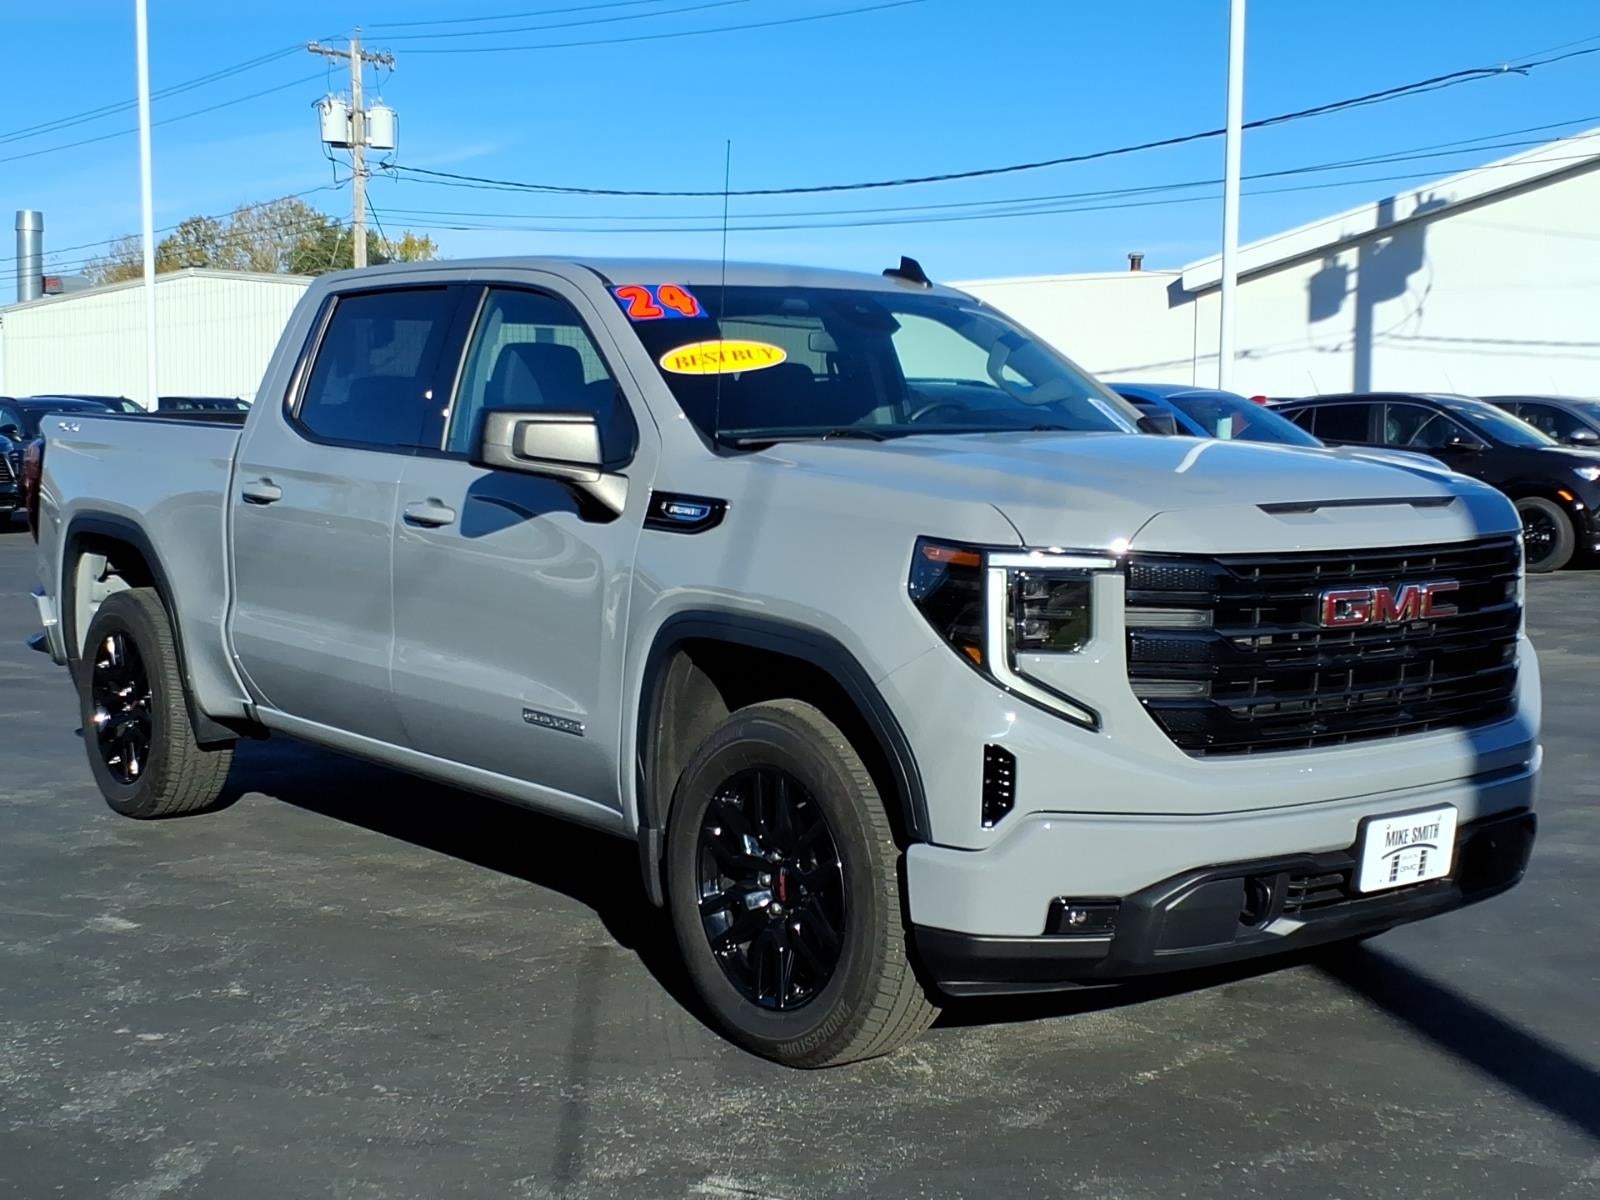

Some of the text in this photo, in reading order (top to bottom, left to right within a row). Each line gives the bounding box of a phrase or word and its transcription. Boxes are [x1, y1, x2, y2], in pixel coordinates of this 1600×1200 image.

[614, 283, 700, 318] 24
[674, 347, 774, 370] BEST BUY
[1319, 580, 1460, 628] GMC
[1385, 823, 1440, 848] MIKE SMITH
